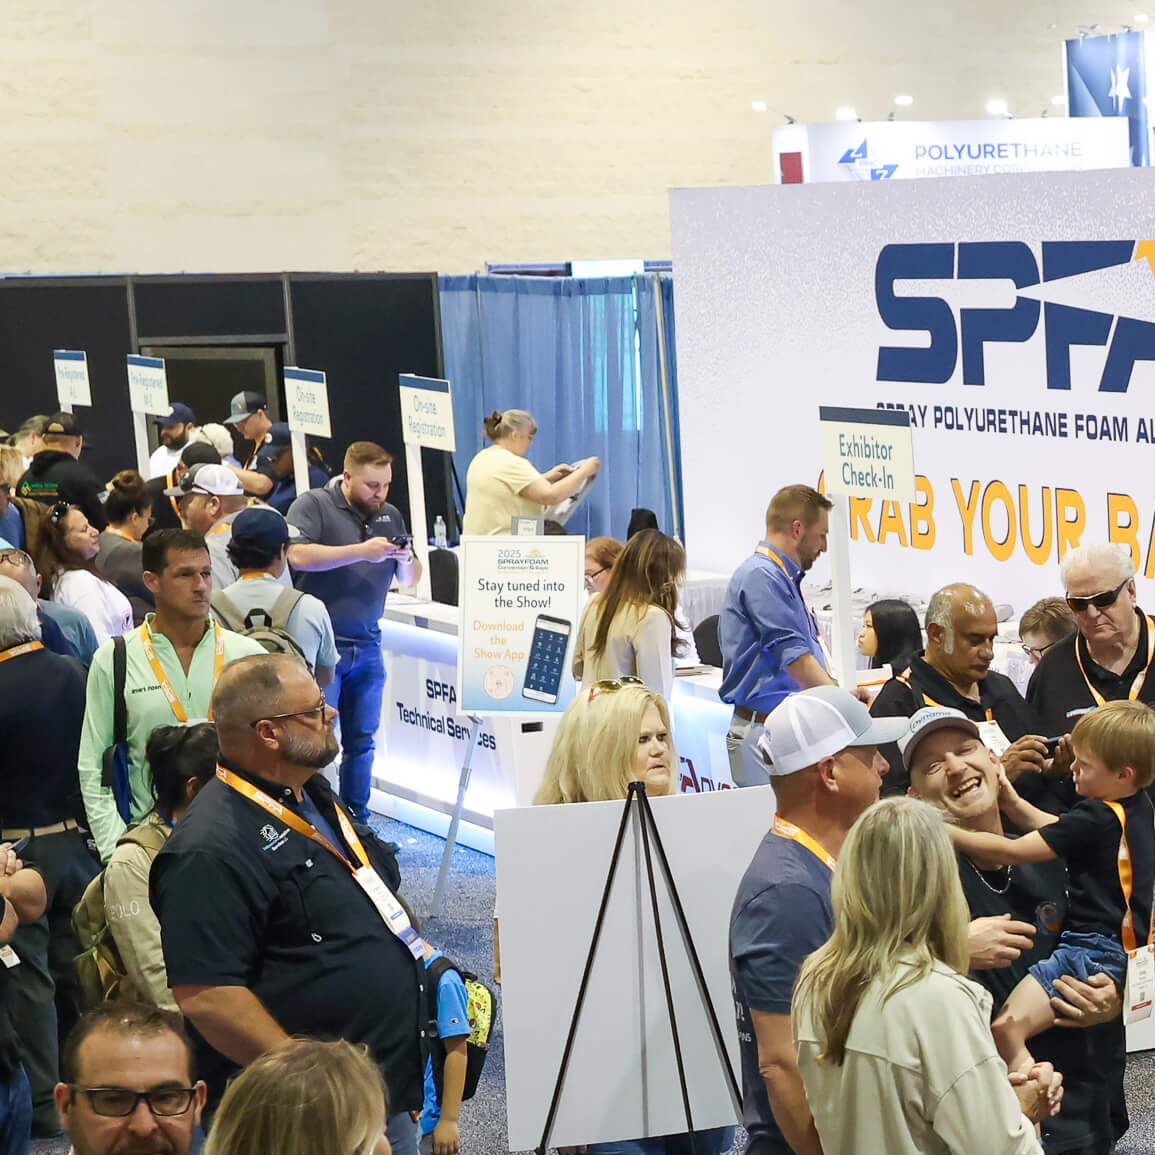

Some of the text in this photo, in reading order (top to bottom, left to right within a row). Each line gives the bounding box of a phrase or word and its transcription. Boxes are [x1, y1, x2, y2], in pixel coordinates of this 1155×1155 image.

[914, 142, 1082, 161] POLYURETHANE
[296, 384, 317, 404] On-site
[292, 405, 324, 426] Registration
[413, 394, 438, 416] On-site
[408, 416, 447, 439] Registration
[933, 405, 1068, 438] POLYURETHANE
[1074, 414, 1128, 442] FOAM
[838, 434, 893, 460] Exhibitor
[841, 462, 894, 489] Check-In
[950, 477, 1086, 566] YOUR
[497, 549, 522, 558] 2025
[478, 578, 565, 595] Stay tuned into
[494, 595, 552, 608] the Show!
[473, 620, 525, 632] Download
[490, 634, 507, 645] the
[474, 648, 525, 662] Show App
[426, 679, 456, 704] SPFA
[396, 702, 446, 734] Technical
